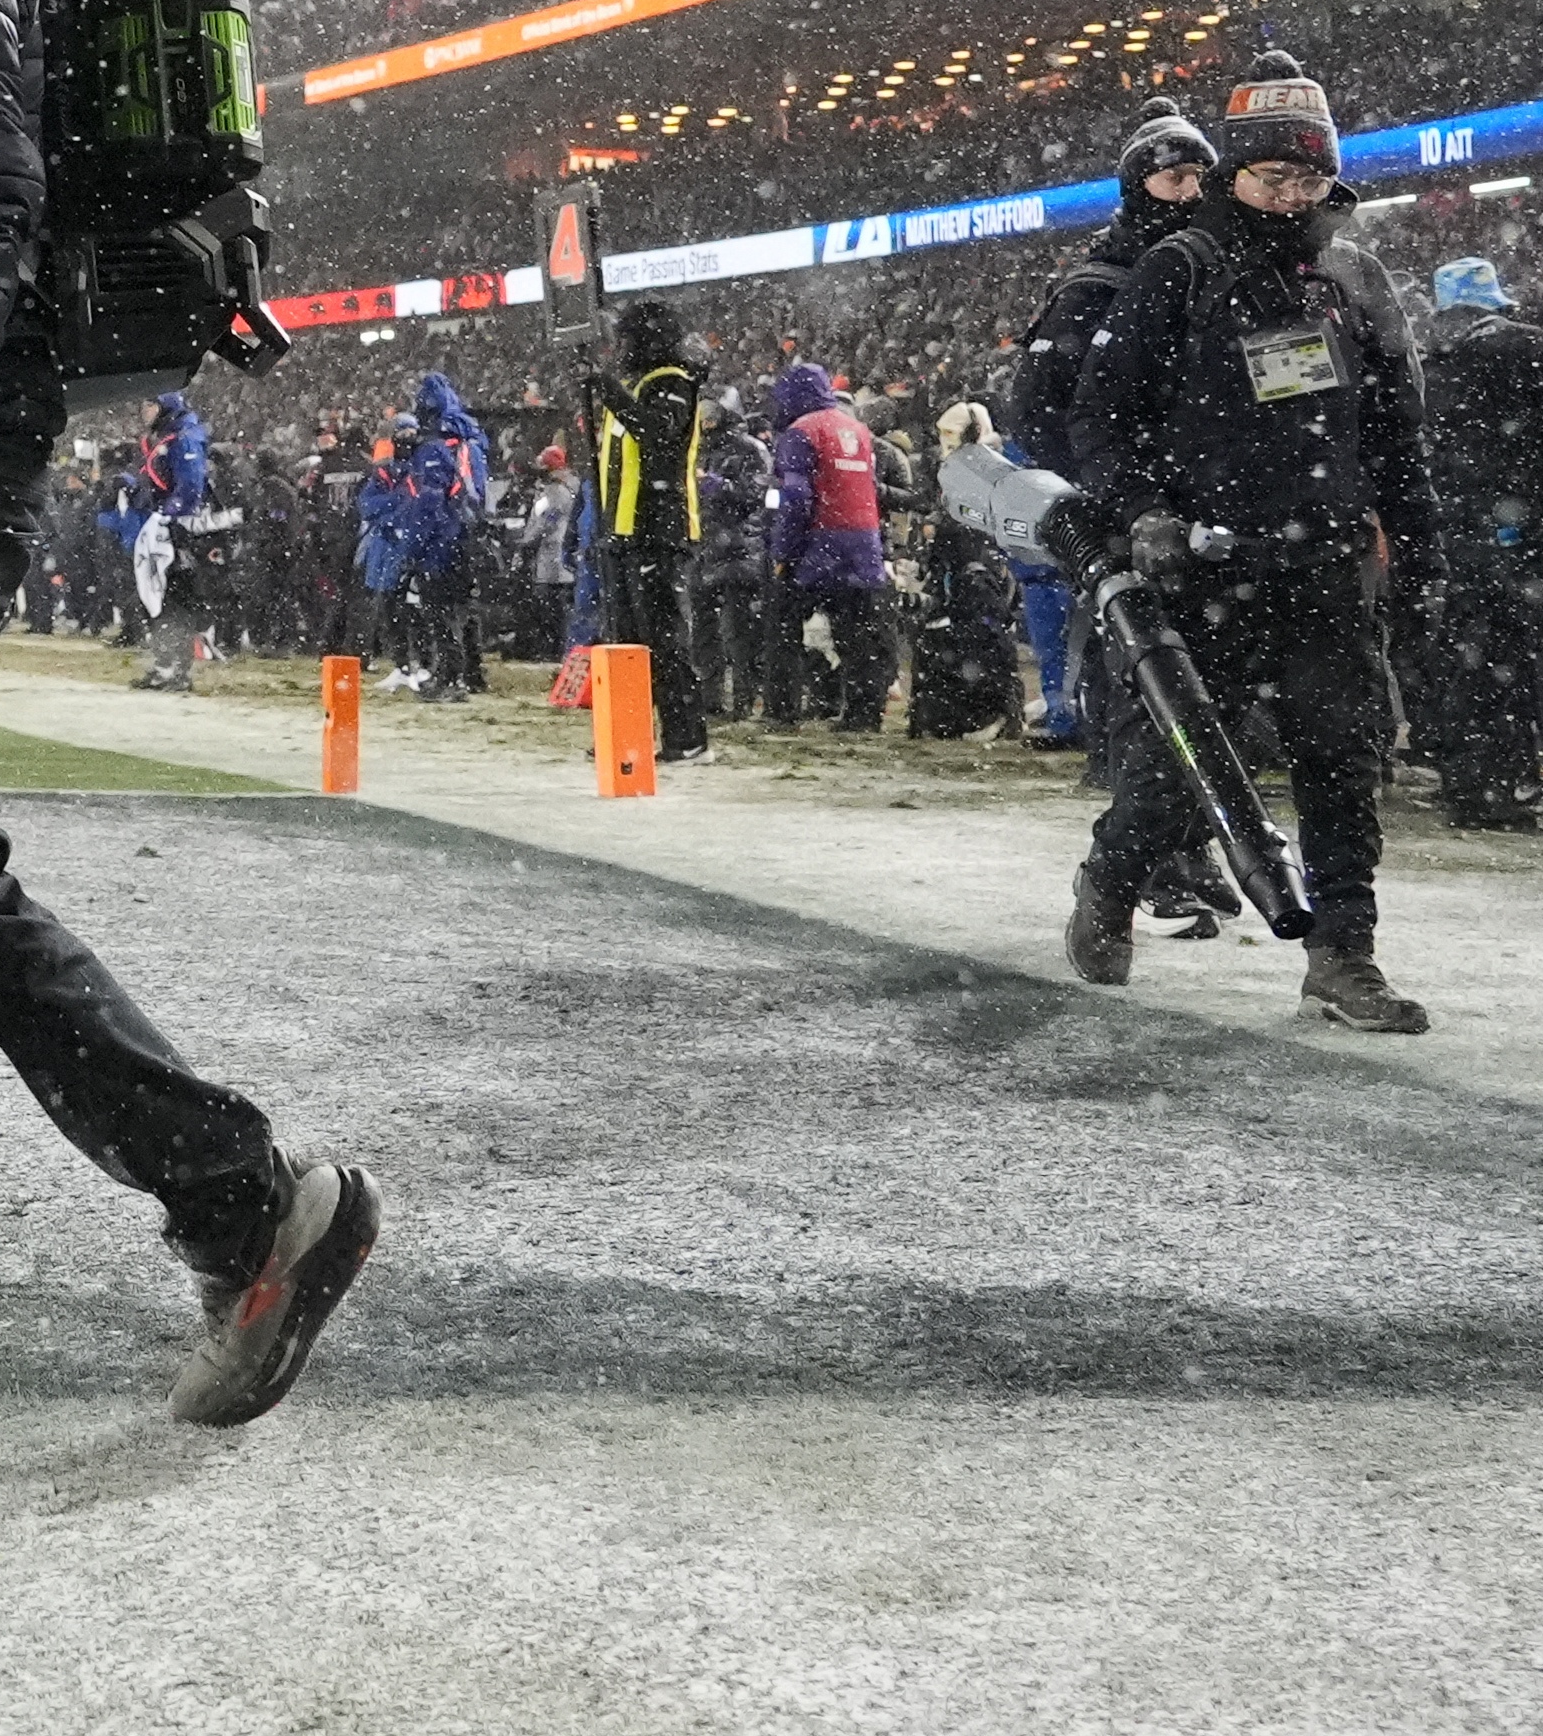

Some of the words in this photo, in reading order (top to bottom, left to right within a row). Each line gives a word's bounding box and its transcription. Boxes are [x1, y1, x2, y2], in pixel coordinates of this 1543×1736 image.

[1419, 127, 1442, 166] 10
[1445, 128, 1474, 162] ATT
[549, 202, 587, 285] 4
[821, 215, 892, 263] LA
[905, 208, 972, 247] MATTHEW
[973, 196, 1044, 238] STAFFORD
[641, 256, 687, 283] Passing
[688, 250, 720, 274] Stats
